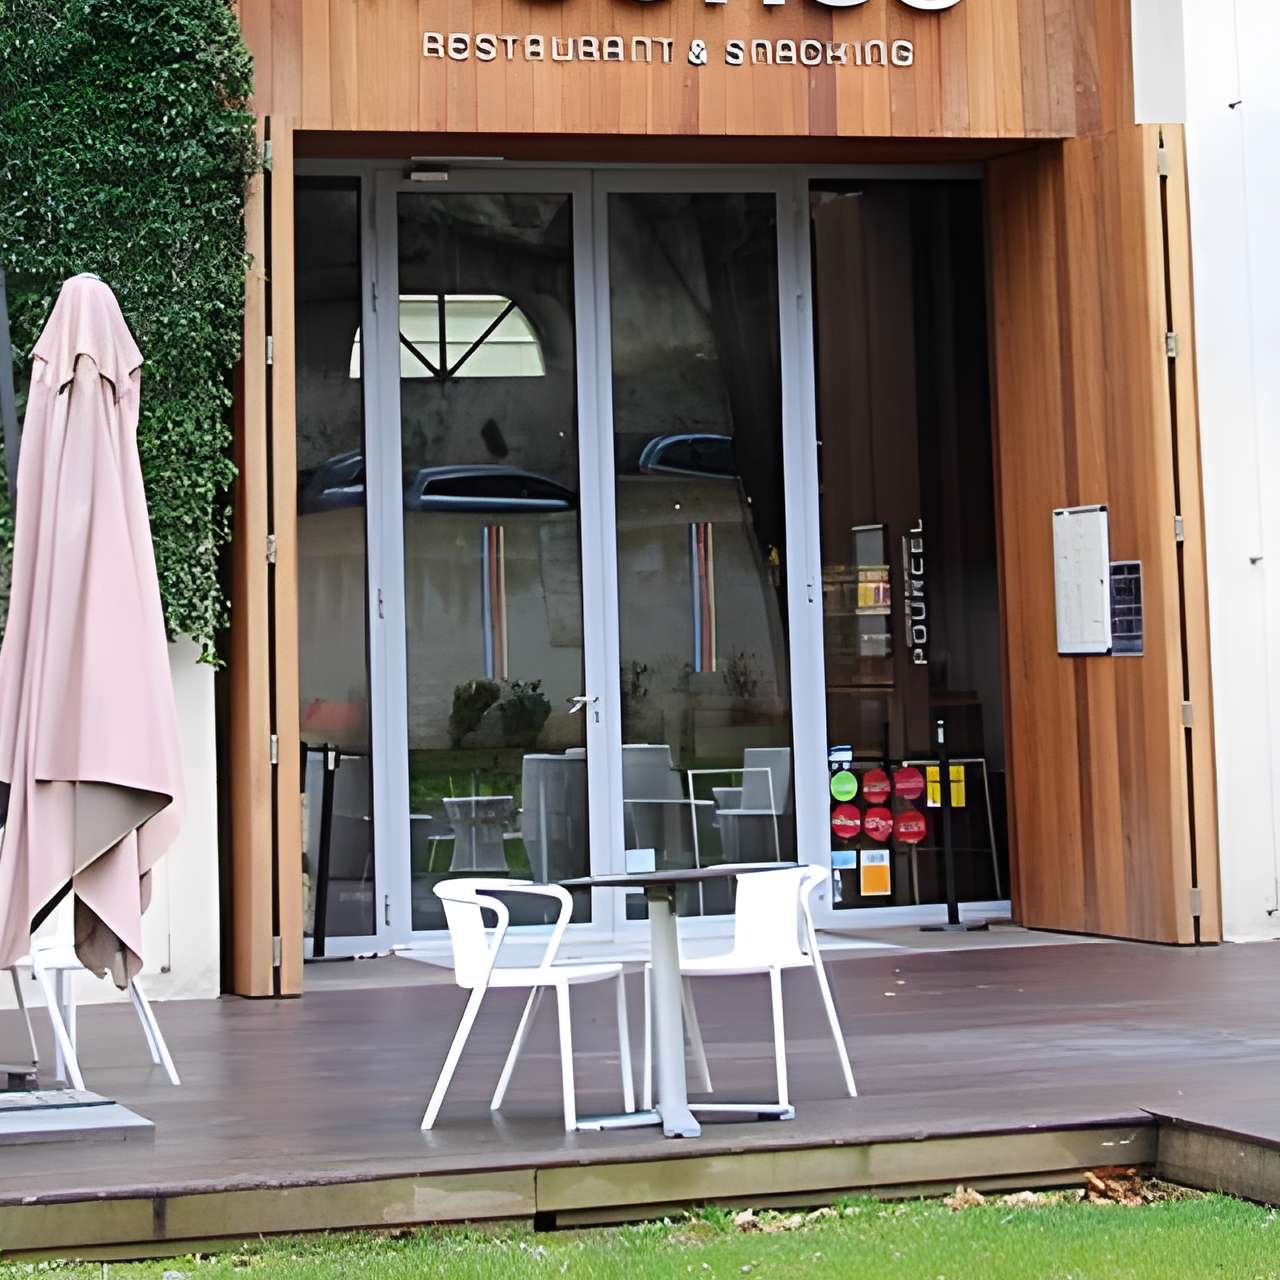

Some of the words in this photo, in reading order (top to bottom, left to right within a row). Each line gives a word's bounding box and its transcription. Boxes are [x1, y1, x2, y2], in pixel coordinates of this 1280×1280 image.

[422, 32, 673, 63] RESTAURANT
[687, 39, 708, 66] &
[725, 39, 914, 66] SNACKING
